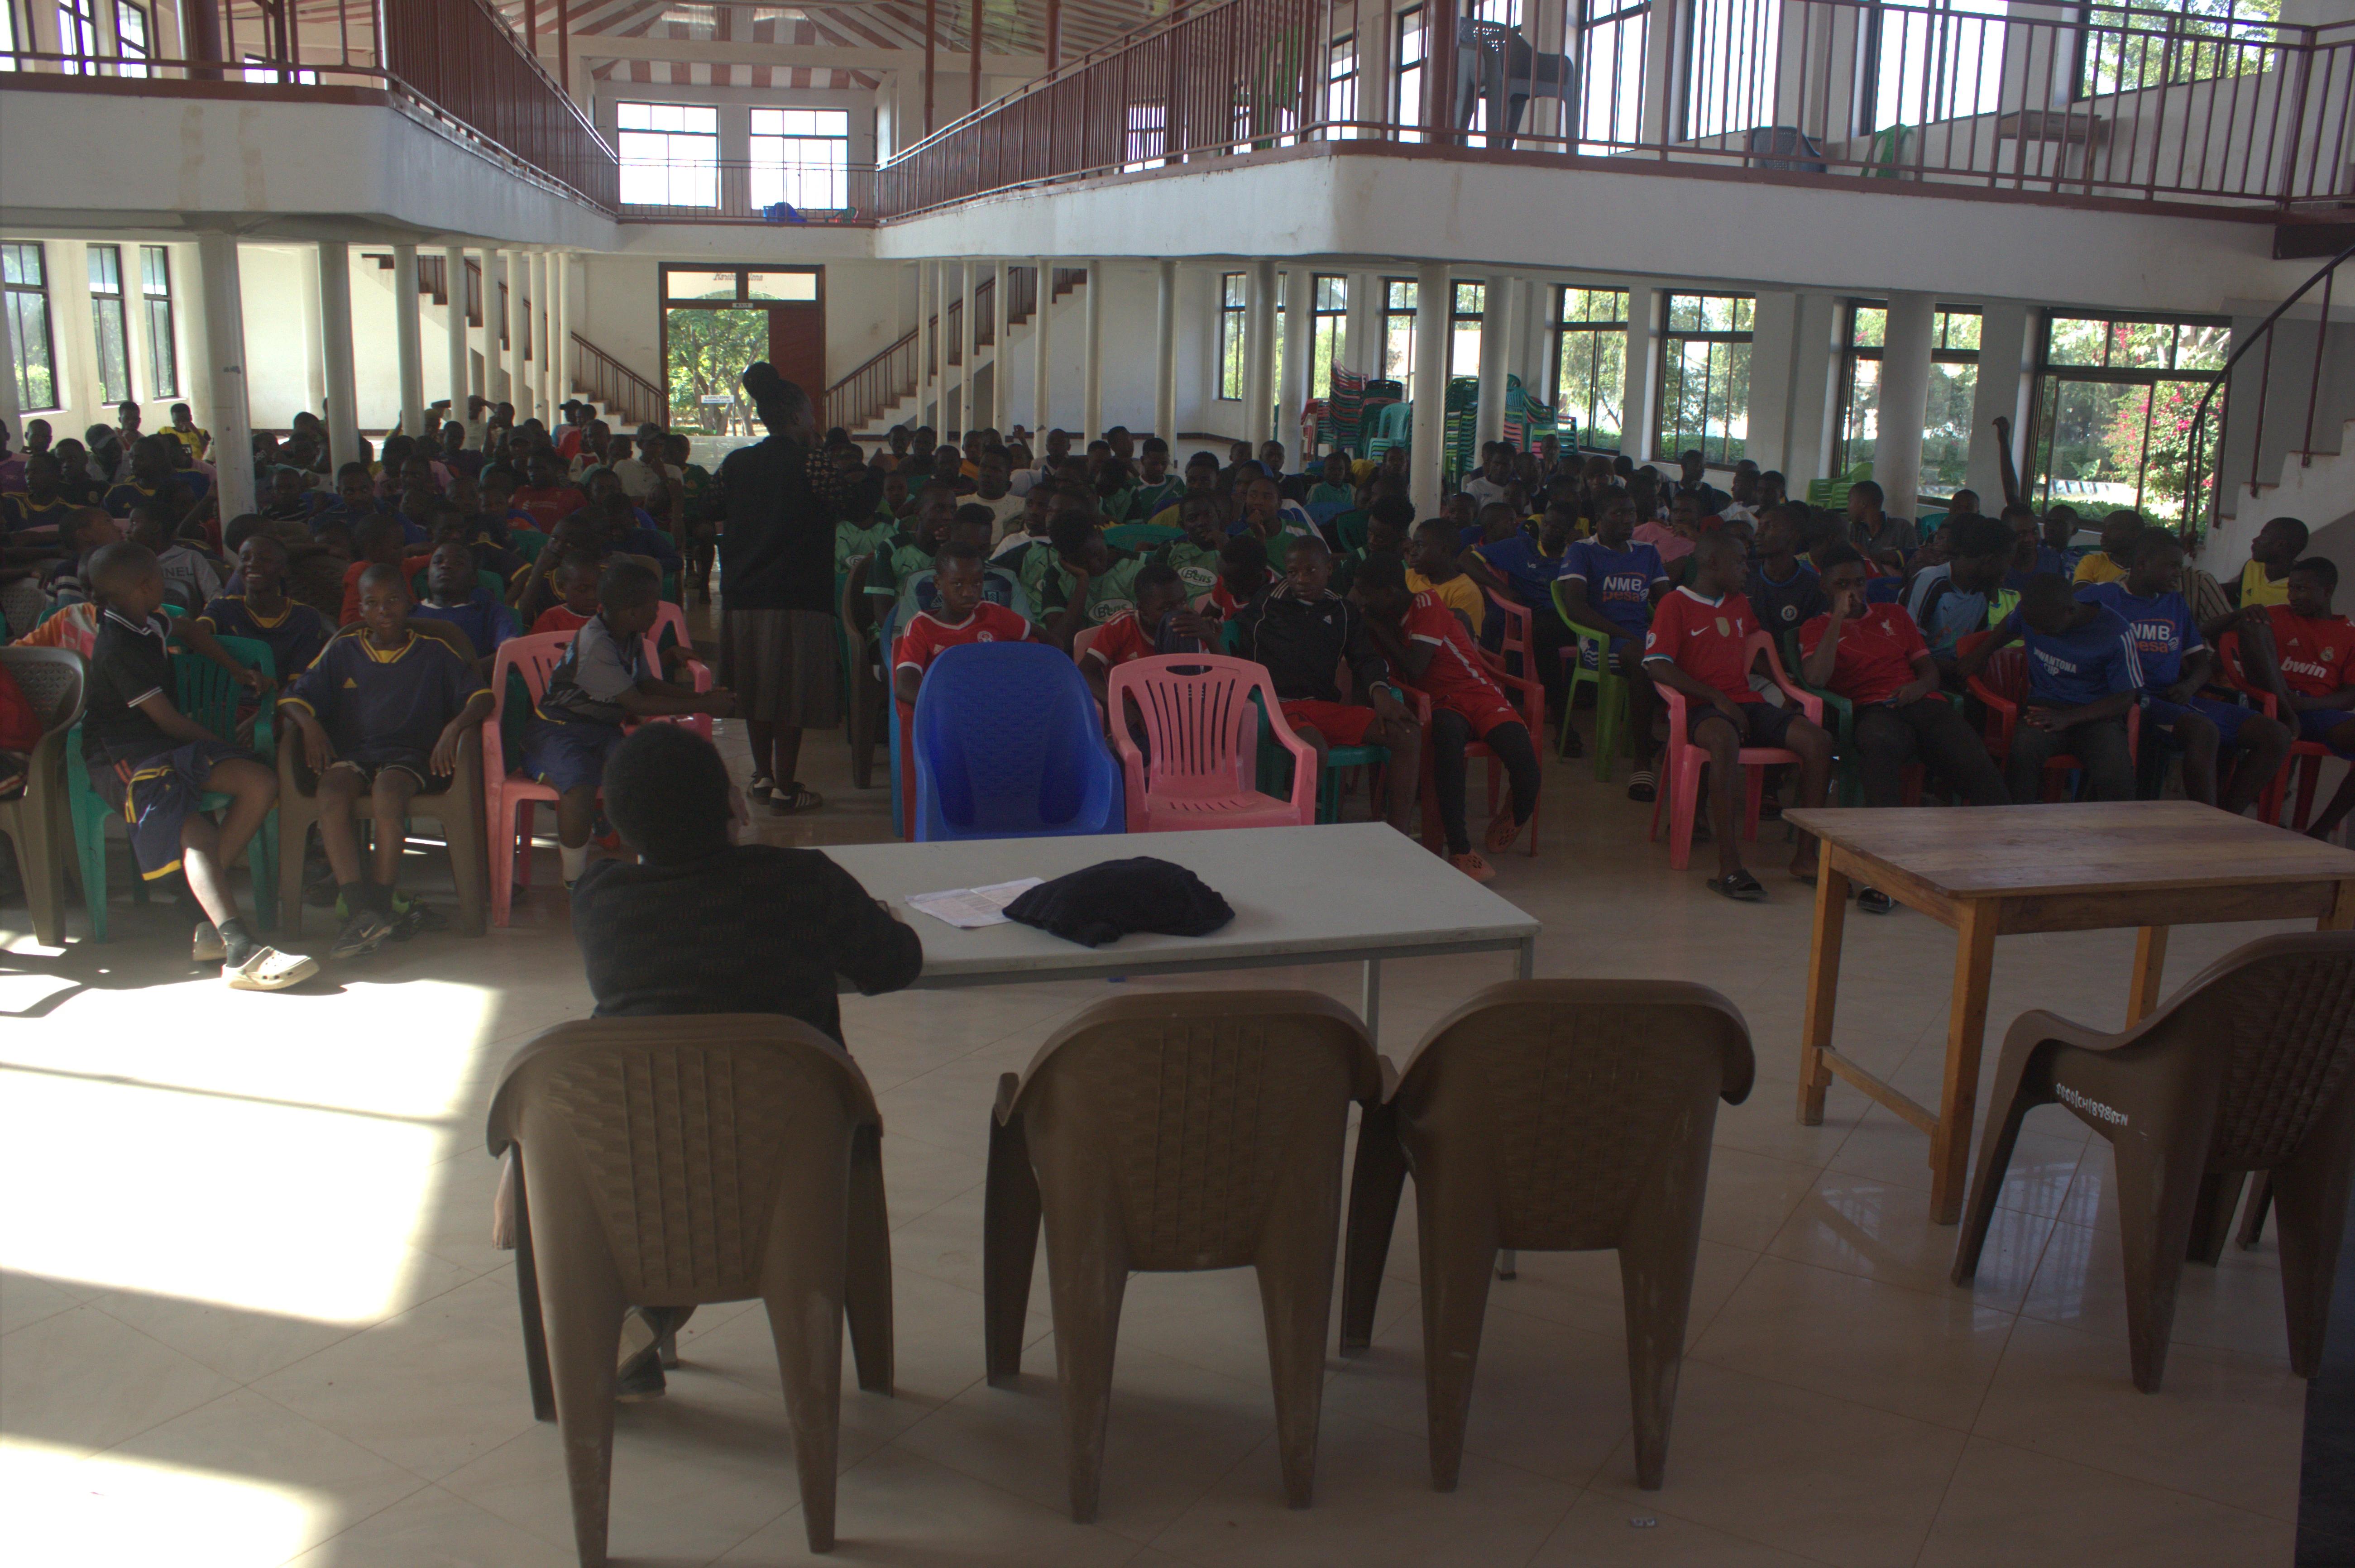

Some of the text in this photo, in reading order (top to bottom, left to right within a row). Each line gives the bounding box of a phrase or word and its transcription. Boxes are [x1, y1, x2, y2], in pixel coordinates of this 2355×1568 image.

[1603, 576, 1642, 592] NMB
[1602, 591, 1640, 602] pesa
[2135, 641, 2168, 654] esa
[2043, 662, 2059, 677] CUP
[2280, 655, 2327, 679] bwin
